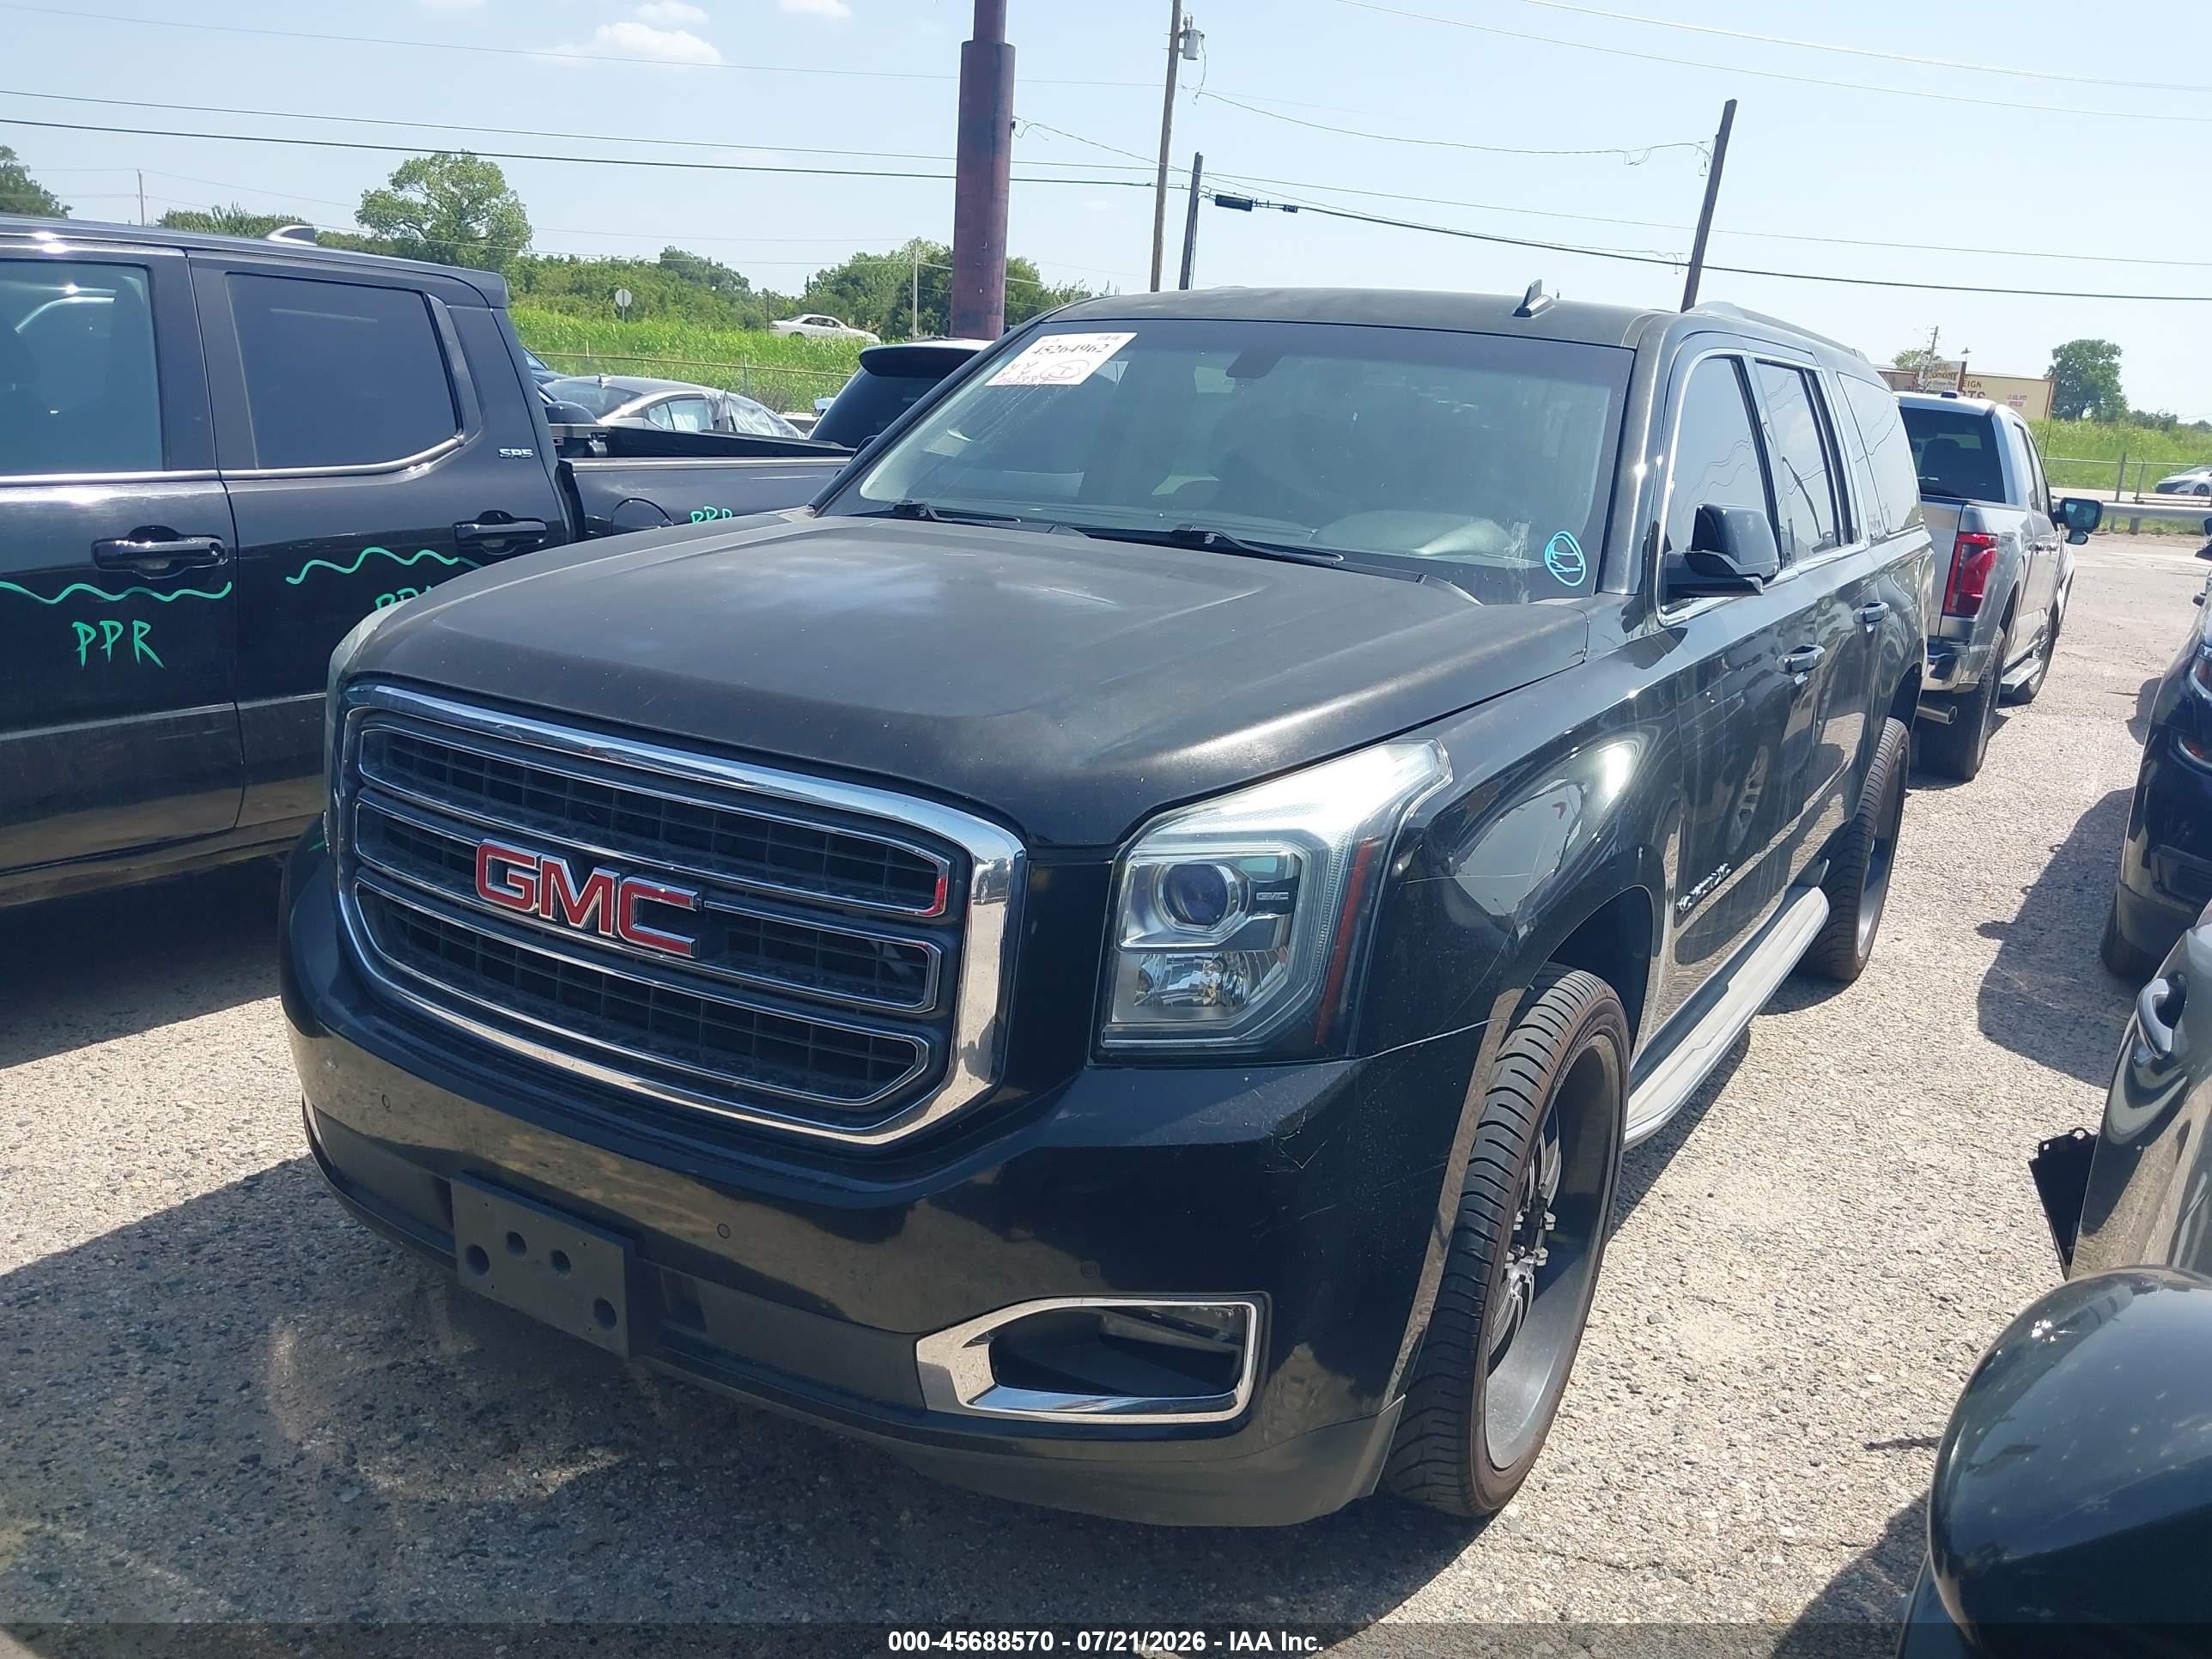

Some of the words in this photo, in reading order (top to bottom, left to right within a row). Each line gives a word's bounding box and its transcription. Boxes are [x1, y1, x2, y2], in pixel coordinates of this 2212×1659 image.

[71, 619, 165, 670] PPR
[476, 839, 698, 958] GMC
[1255, 891, 1290, 901] GMC
